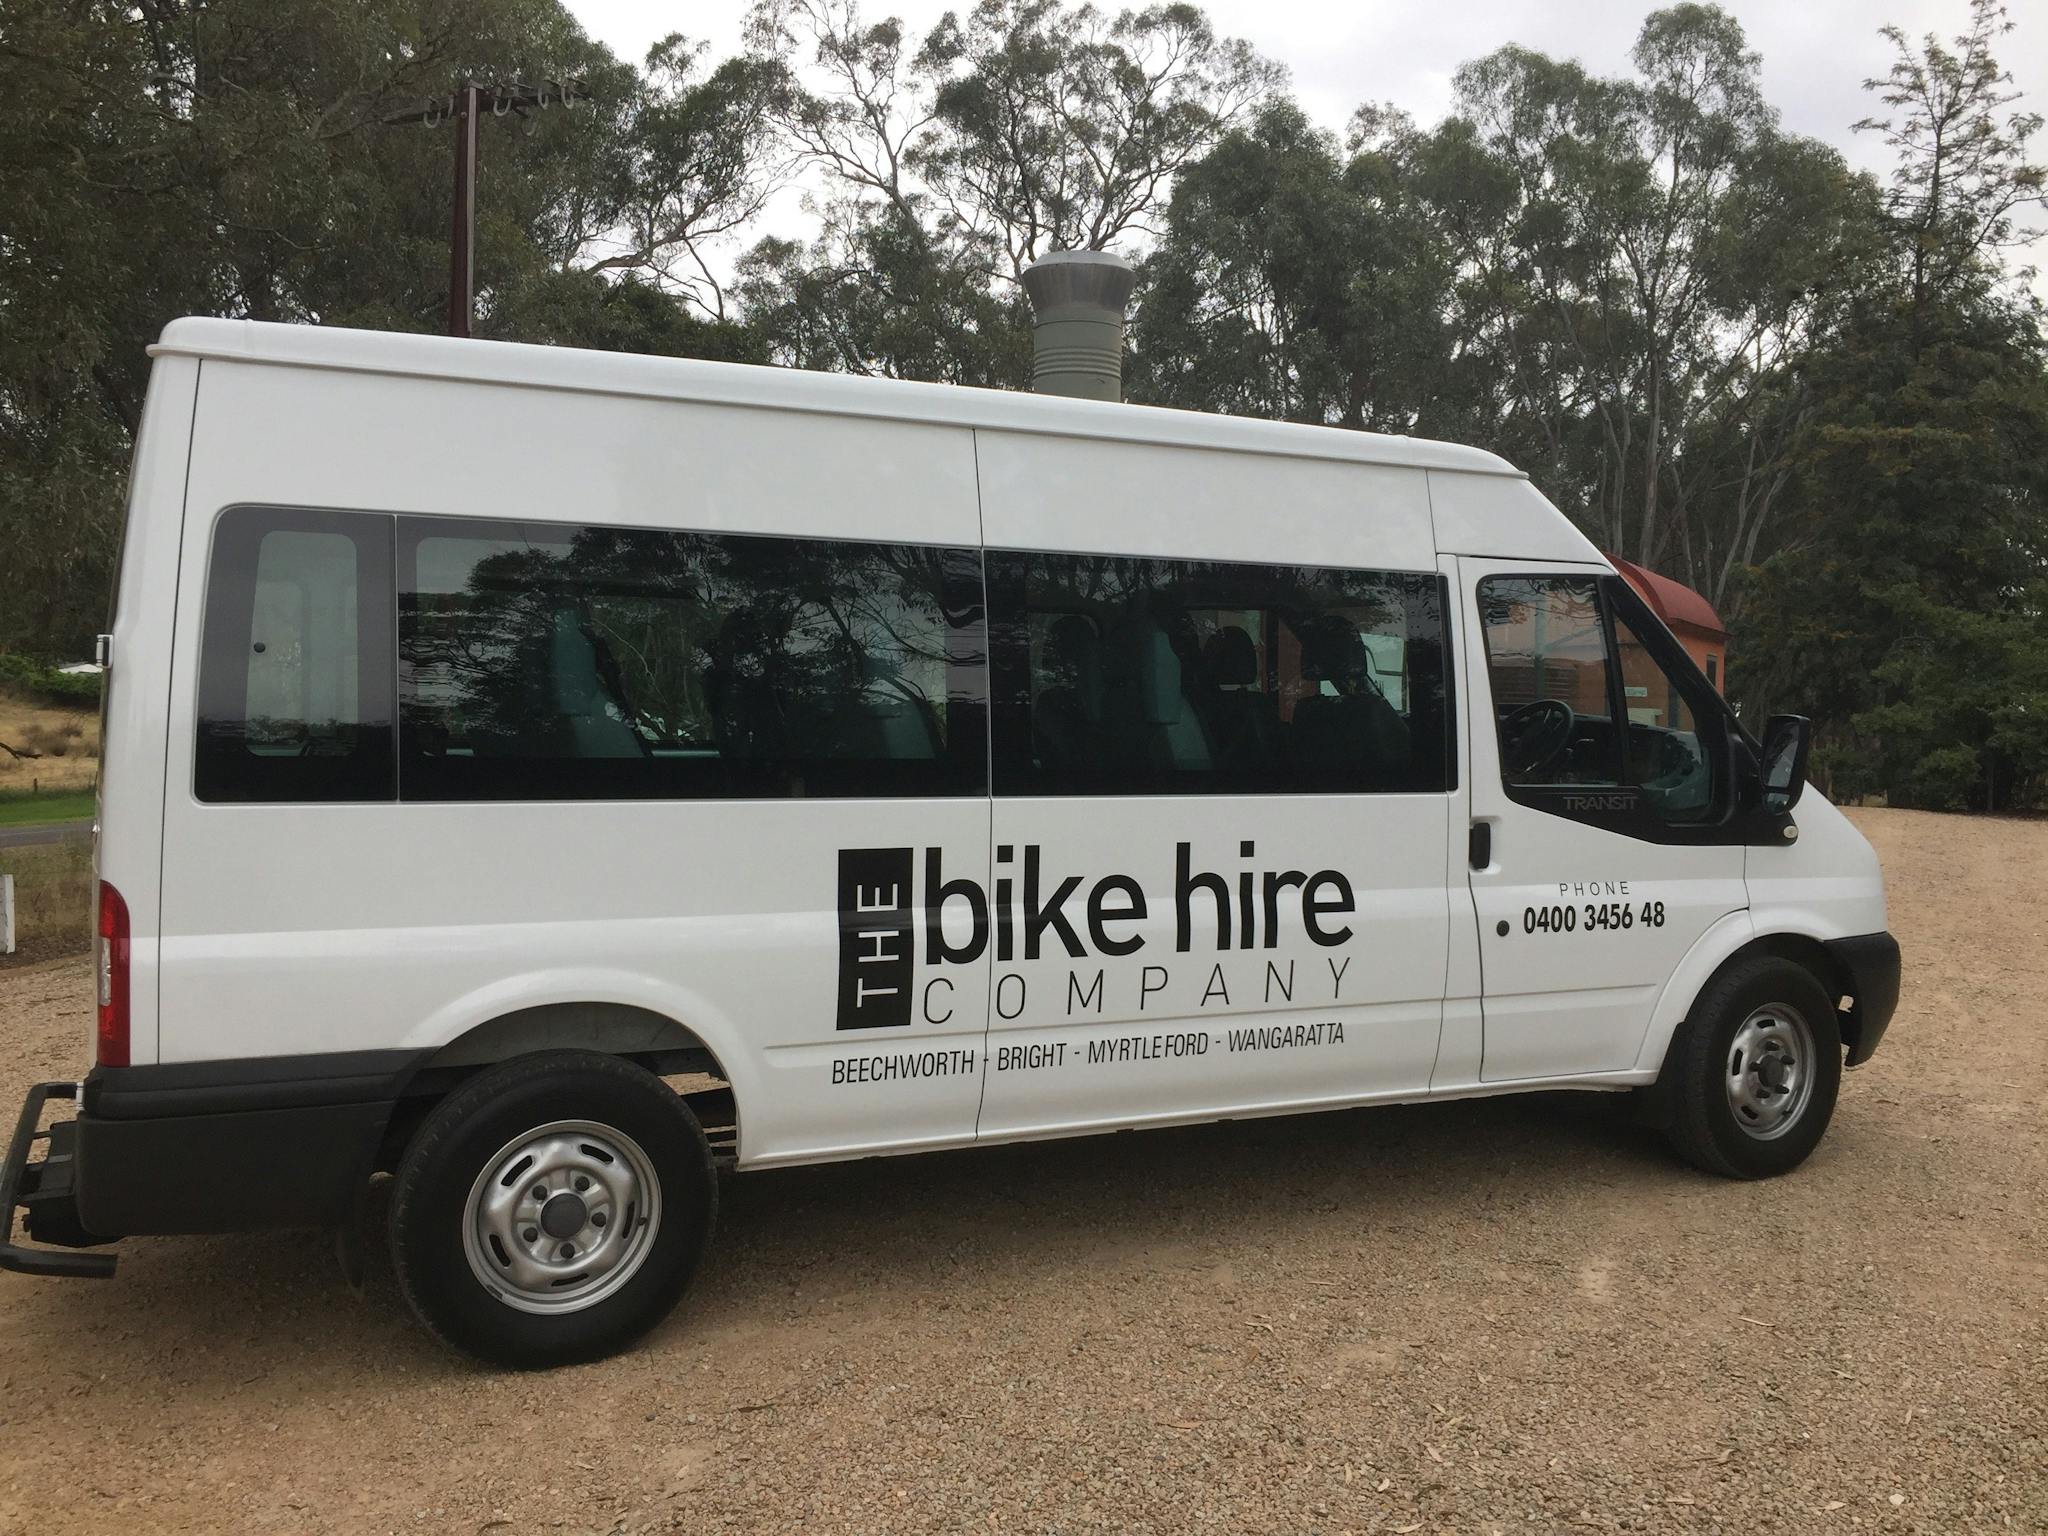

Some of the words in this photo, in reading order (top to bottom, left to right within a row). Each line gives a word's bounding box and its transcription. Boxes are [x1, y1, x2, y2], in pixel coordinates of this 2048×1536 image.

[1563, 796, 1638, 811] TRANSIT
[926, 844, 1147, 964] bike
[1176, 840, 1355, 953] hire
[1523, 905, 1576, 934] 0400
[1584, 903, 1633, 931] 3456
[1640, 901, 1665, 928] 48
[1560, 882, 1630, 896] PHONE
[856, 882, 899, 1008] THE
[923, 957, 1350, 1024] COMPANY
[832, 1050, 974, 1084] BEECHWORTH
[997, 1043, 1067, 1071] BRIGHT
[1087, 1032, 1209, 1064] MYRTLEFORD
[1228, 1023, 1344, 1053] WANGARATTA
